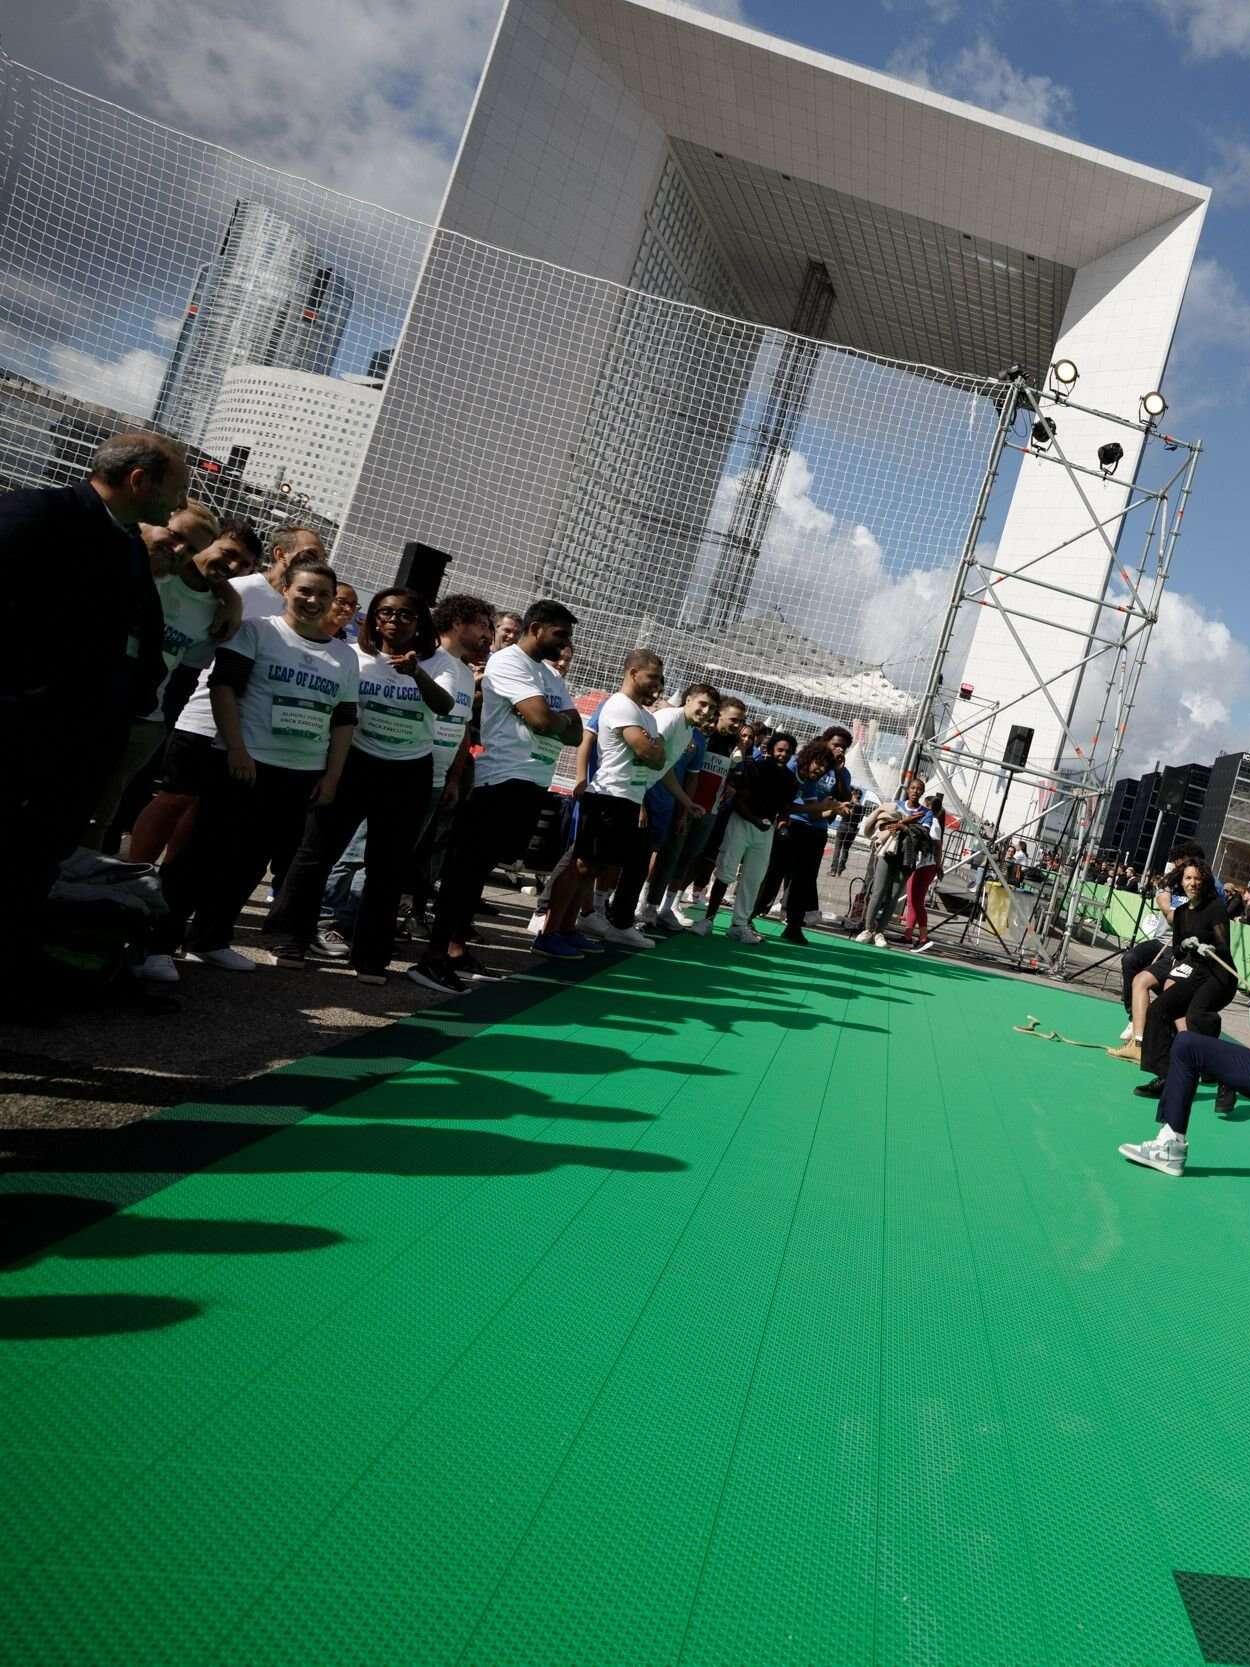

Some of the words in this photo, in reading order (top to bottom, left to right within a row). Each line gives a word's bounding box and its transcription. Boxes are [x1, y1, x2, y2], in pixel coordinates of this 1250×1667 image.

[268, 665, 295, 682] LEAP
[295, 671, 310, 687] OF
[358, 680, 382, 697] LEAP
[383, 685, 396, 700] OF
